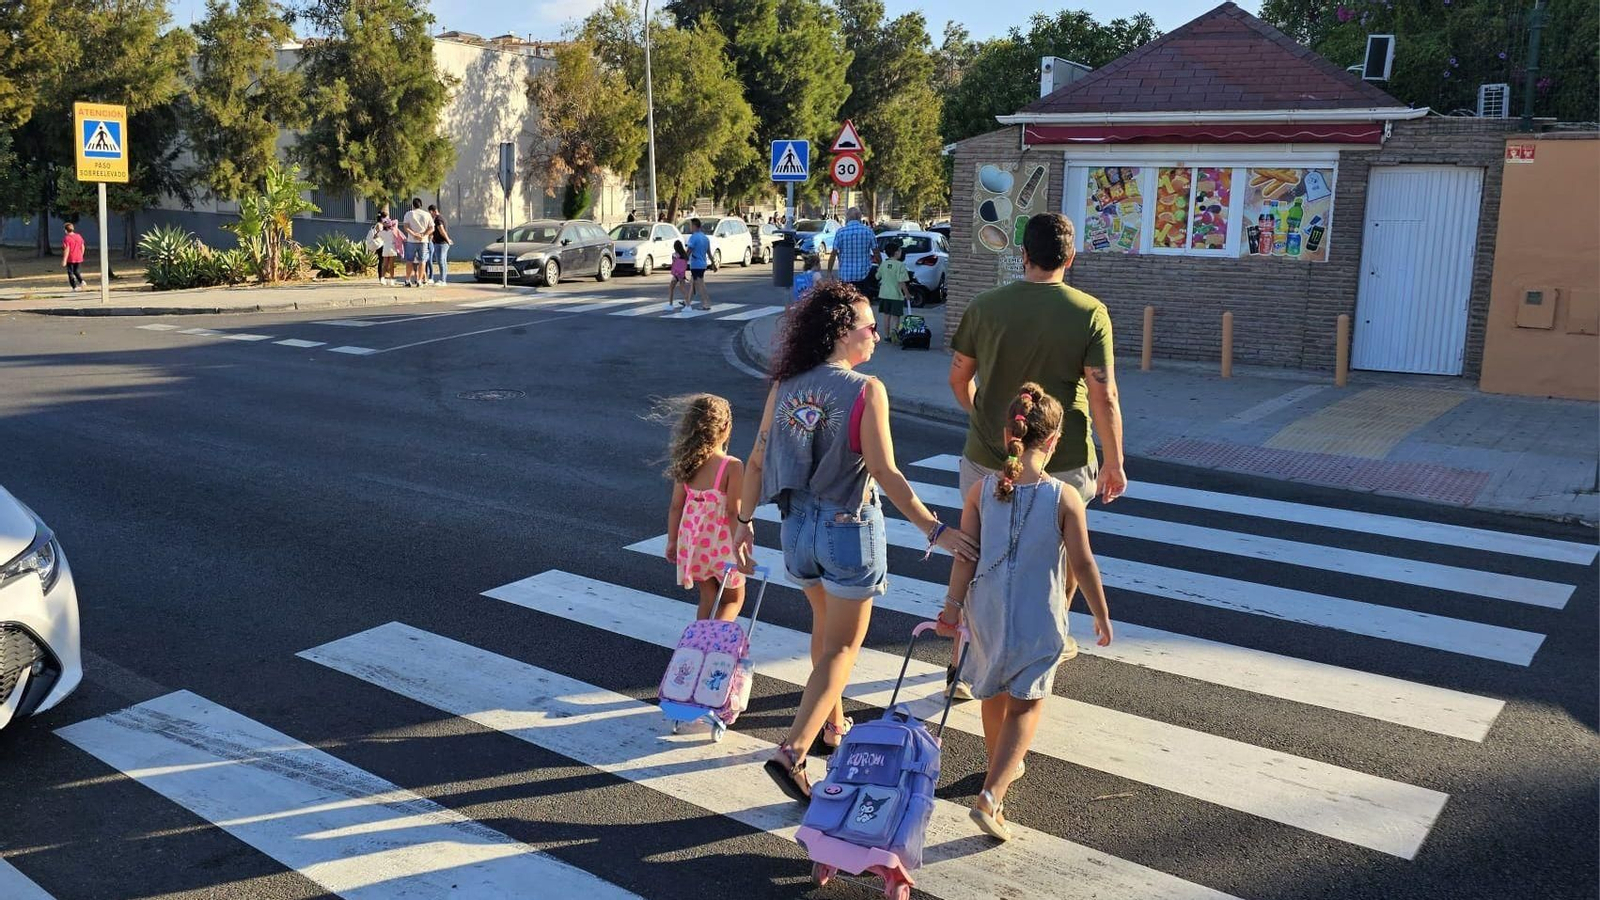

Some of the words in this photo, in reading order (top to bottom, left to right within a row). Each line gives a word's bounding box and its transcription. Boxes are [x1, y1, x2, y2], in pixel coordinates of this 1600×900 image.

[79, 169, 127, 178] SOBREELEVADO
[838, 164, 856, 175] 30
[846, 752, 885, 767] KUROMI
